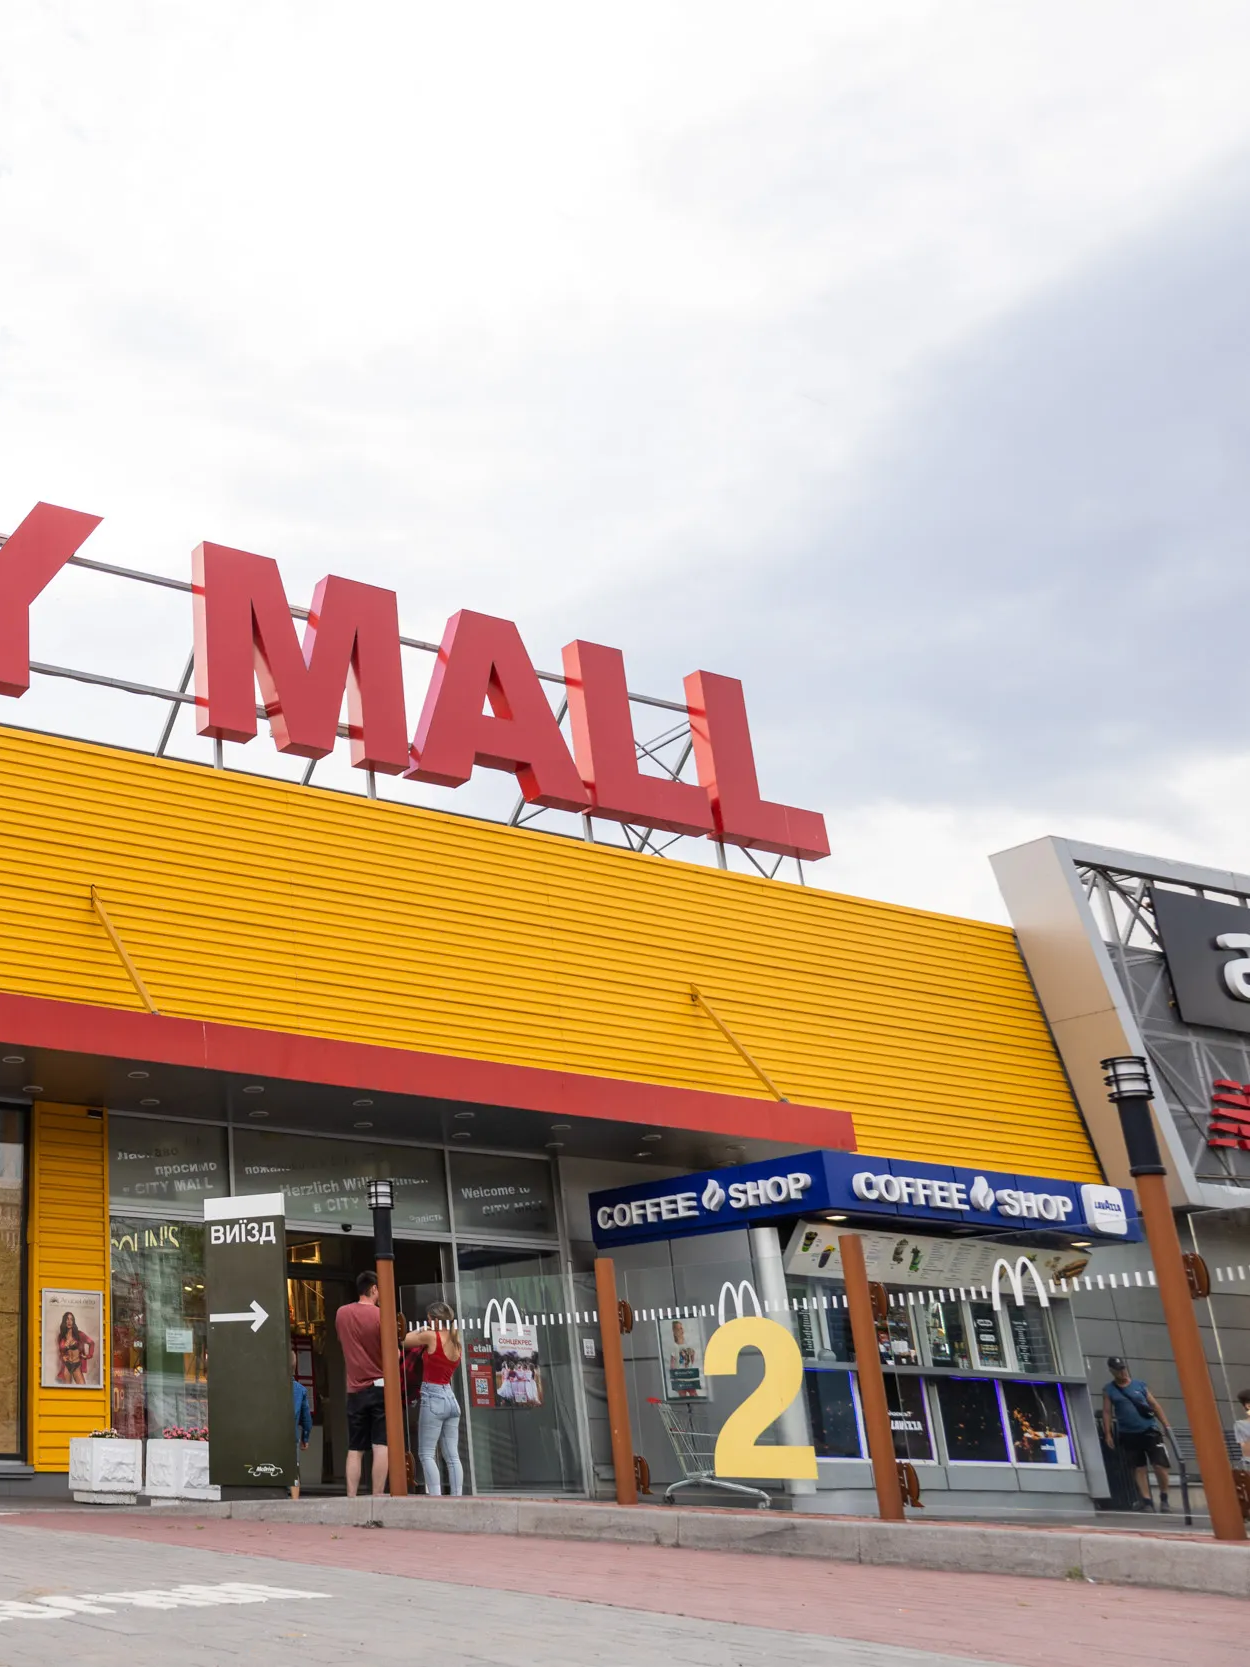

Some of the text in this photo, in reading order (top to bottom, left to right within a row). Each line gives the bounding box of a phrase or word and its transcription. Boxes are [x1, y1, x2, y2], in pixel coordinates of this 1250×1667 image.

[192, 541, 831, 861] MALL
[135, 1181, 169, 1195] CITY
[174, 1177, 214, 1192] MALL
[279, 1180, 340, 1196] Herzlich
[461, 1186, 516, 1200] Welcome
[852, 1172, 1073, 1221] COFFEE SHOP
[326, 1197, 359, 1211] CITY
[597, 1172, 811, 1230] COFFEE SHOP
[211, 1220, 277, 1245] ВИЇЗД
[704, 1316, 819, 1479] 2
